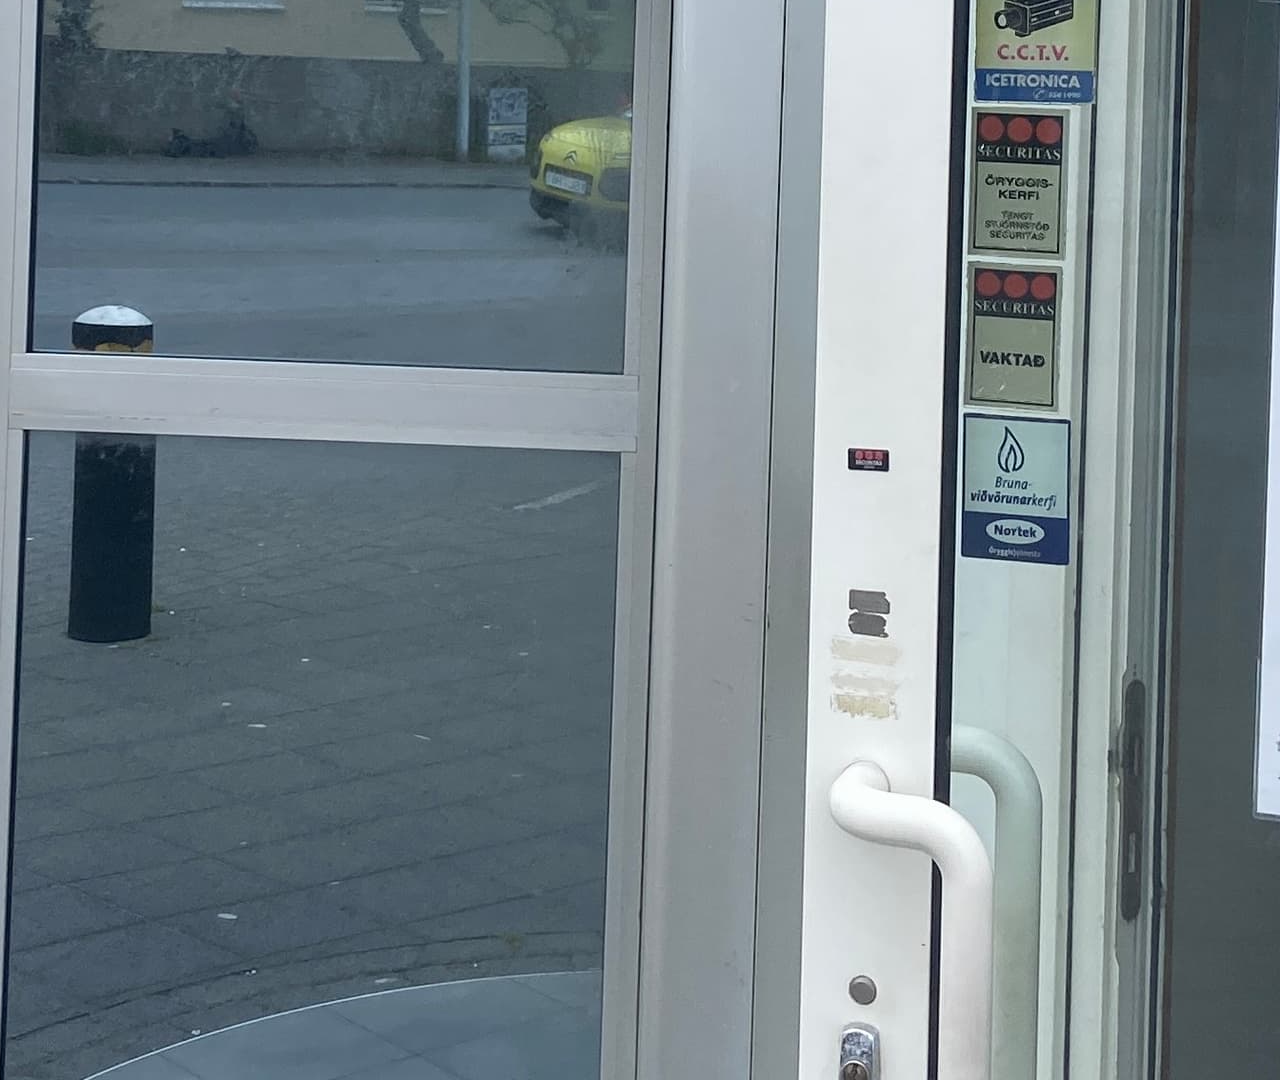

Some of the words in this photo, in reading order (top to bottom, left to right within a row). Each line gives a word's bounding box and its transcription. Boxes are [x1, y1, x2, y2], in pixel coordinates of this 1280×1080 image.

[997, 44, 1070, 61] C.C.T.V.
[985, 73, 1081, 89] ICETRONICA
[977, 143, 1061, 161] SECURITAS
[985, 173, 1054, 189] ÖRYGGIS-
[998, 189, 1040, 201] KERFI
[989, 230, 1046, 241] SECURITAS
[974, 299, 1055, 316] SECURITAS
[980, 350, 1046, 368] VAKTAÐ
[994, 476, 1033, 490] Bruna-
[970, 490, 1057, 511] viðvörunarkerfi
[993, 524, 1037, 538] Nortek
